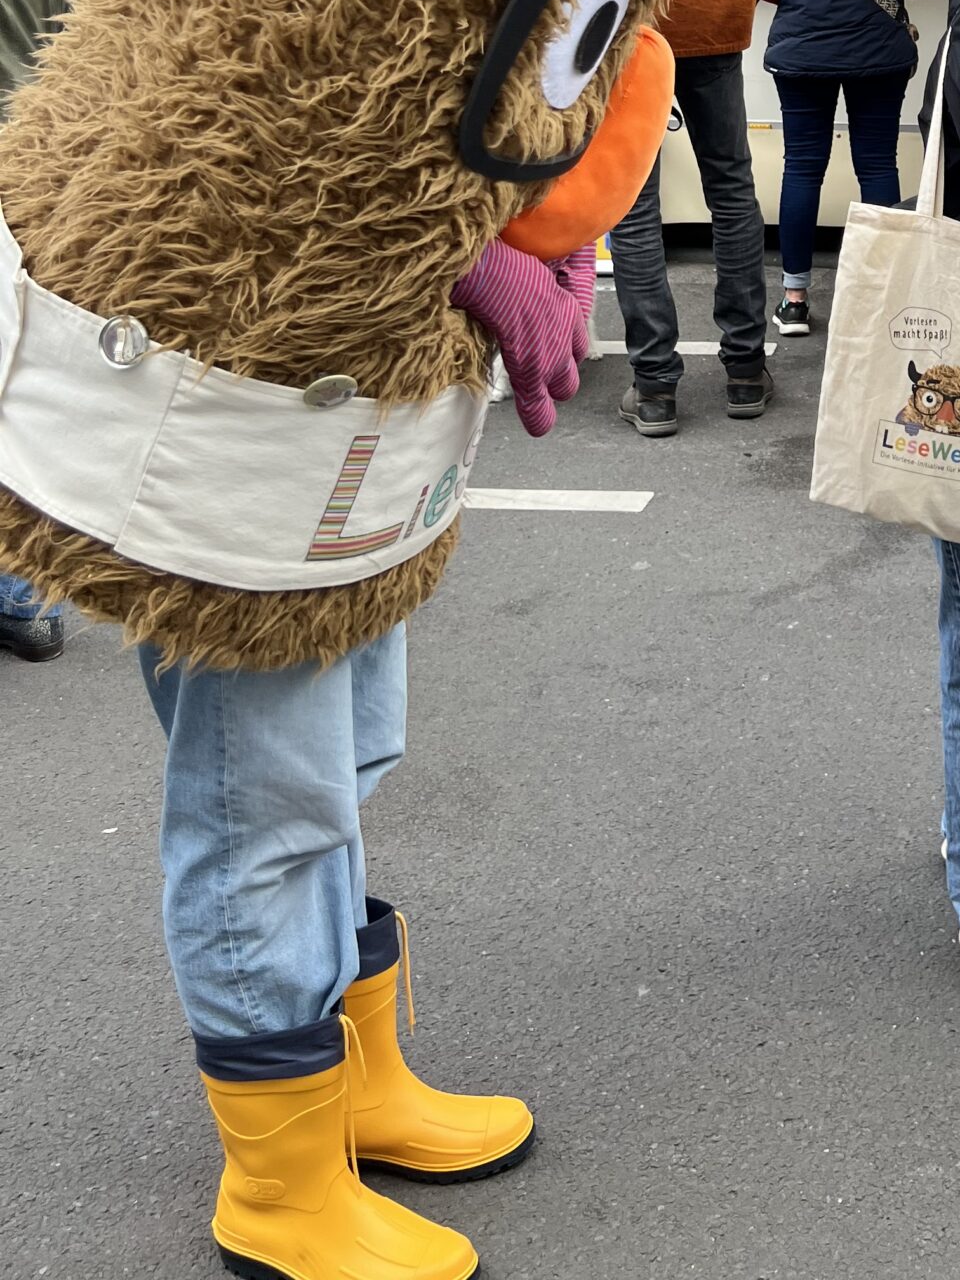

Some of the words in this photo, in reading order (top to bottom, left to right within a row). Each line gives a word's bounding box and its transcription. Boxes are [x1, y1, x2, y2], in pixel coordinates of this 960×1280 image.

[904, 316, 938, 326] Vorlesen
[893, 329, 921, 339] macht
[923, 328, 948, 341] Spaß!
